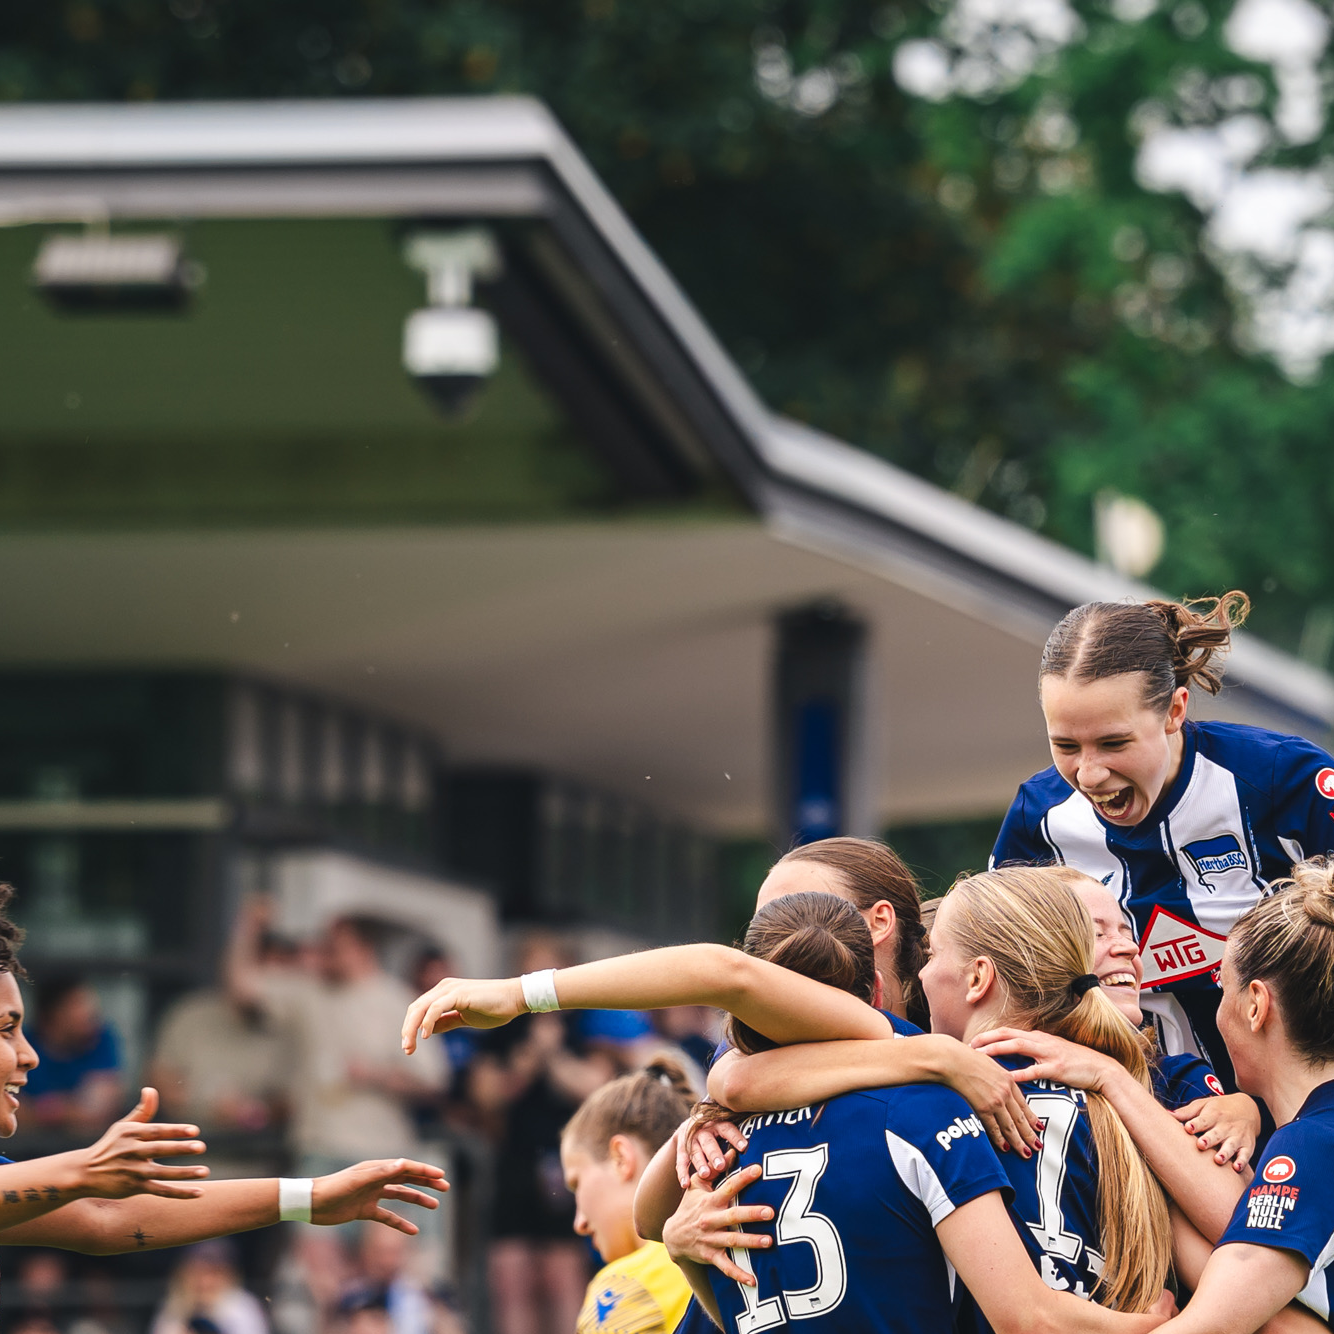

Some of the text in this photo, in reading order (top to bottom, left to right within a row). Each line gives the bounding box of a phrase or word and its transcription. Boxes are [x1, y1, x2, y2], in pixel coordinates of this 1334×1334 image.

[1198, 852, 1245, 872] Hertha BSC
[1149, 934, 1207, 973] WTG
[1249, 1184, 1300, 1200] MAMPE
[1247, 1194, 1296, 1211] BERLIN
[1249, 1205, 1284, 1220] NULL
[1246, 1215, 1282, 1230] NULL
